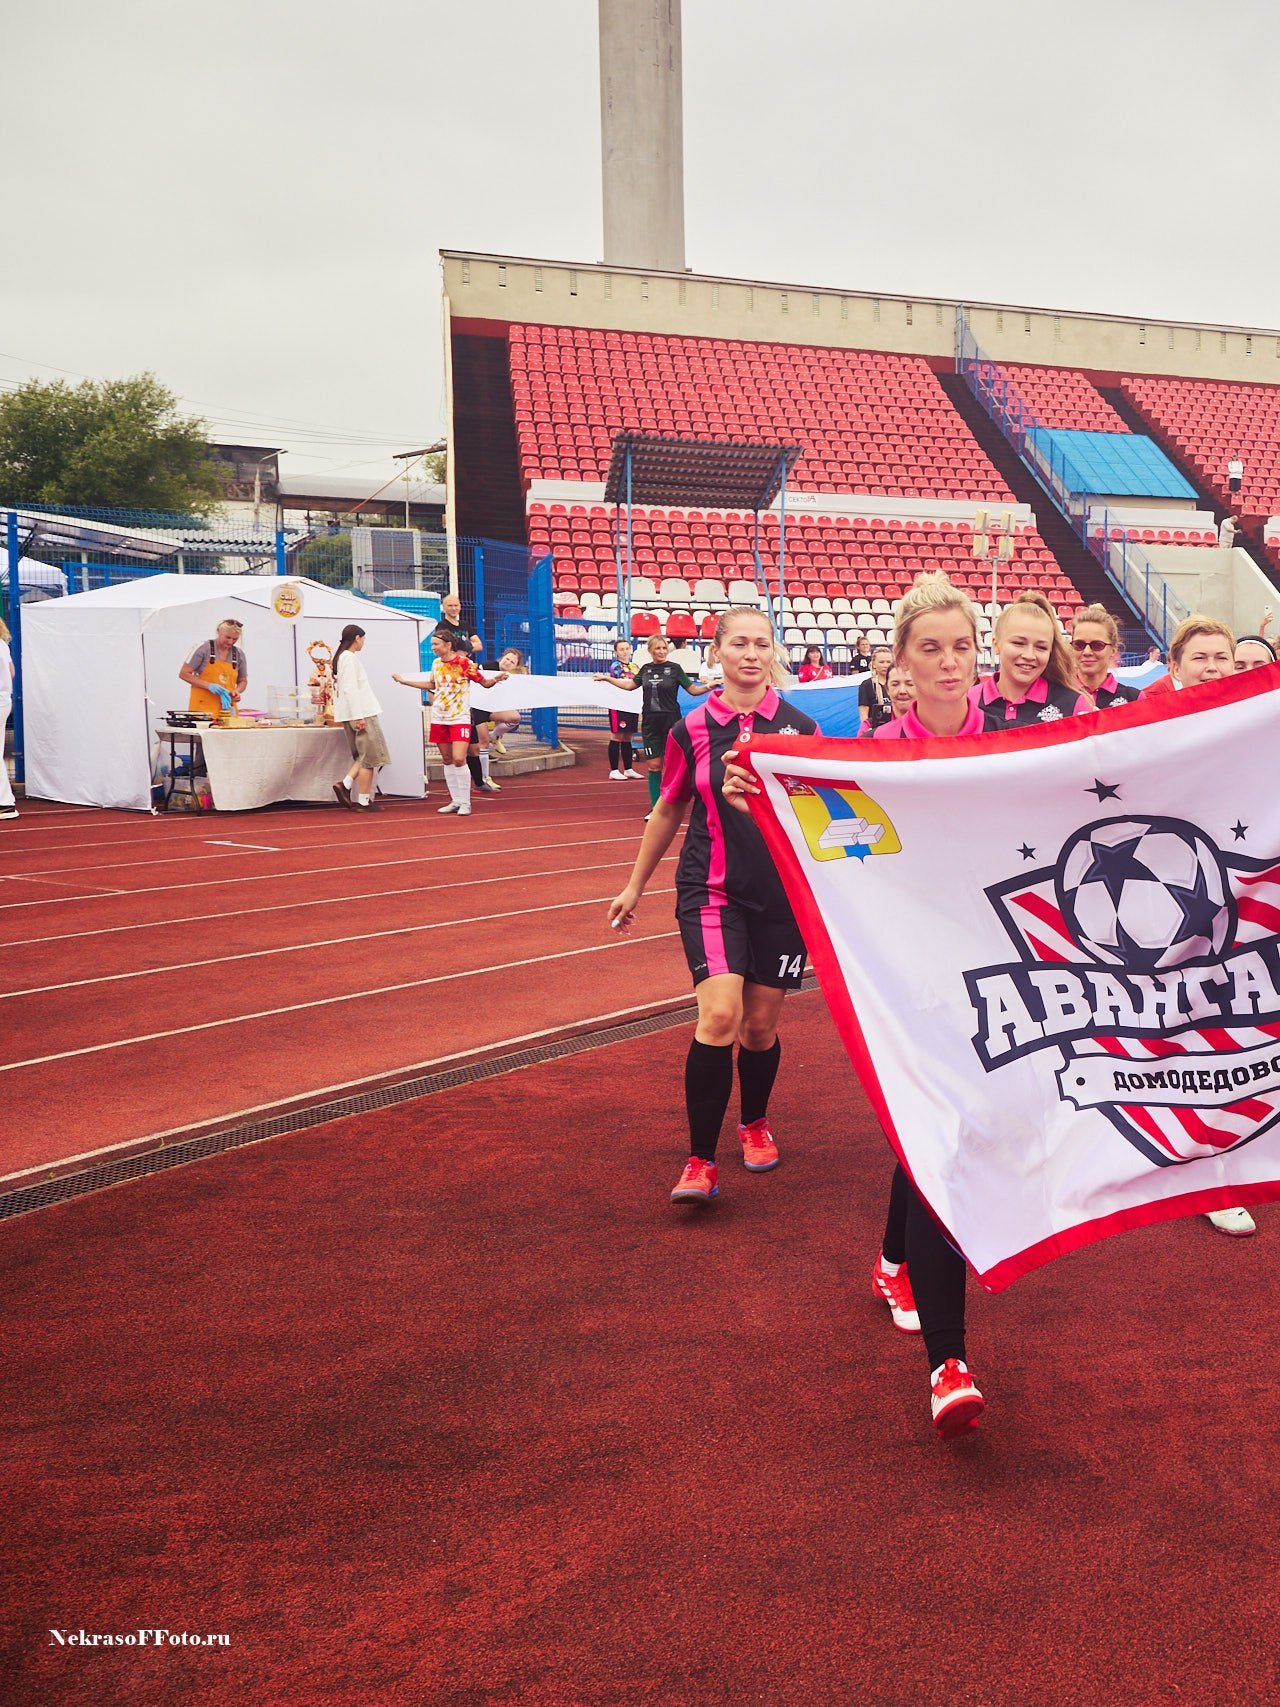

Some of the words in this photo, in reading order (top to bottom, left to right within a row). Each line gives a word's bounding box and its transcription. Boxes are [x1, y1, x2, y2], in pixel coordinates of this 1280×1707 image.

[460, 727, 470, 738] 15
[645, 747, 653, 756] 11
[778, 954, 802, 978] 14
